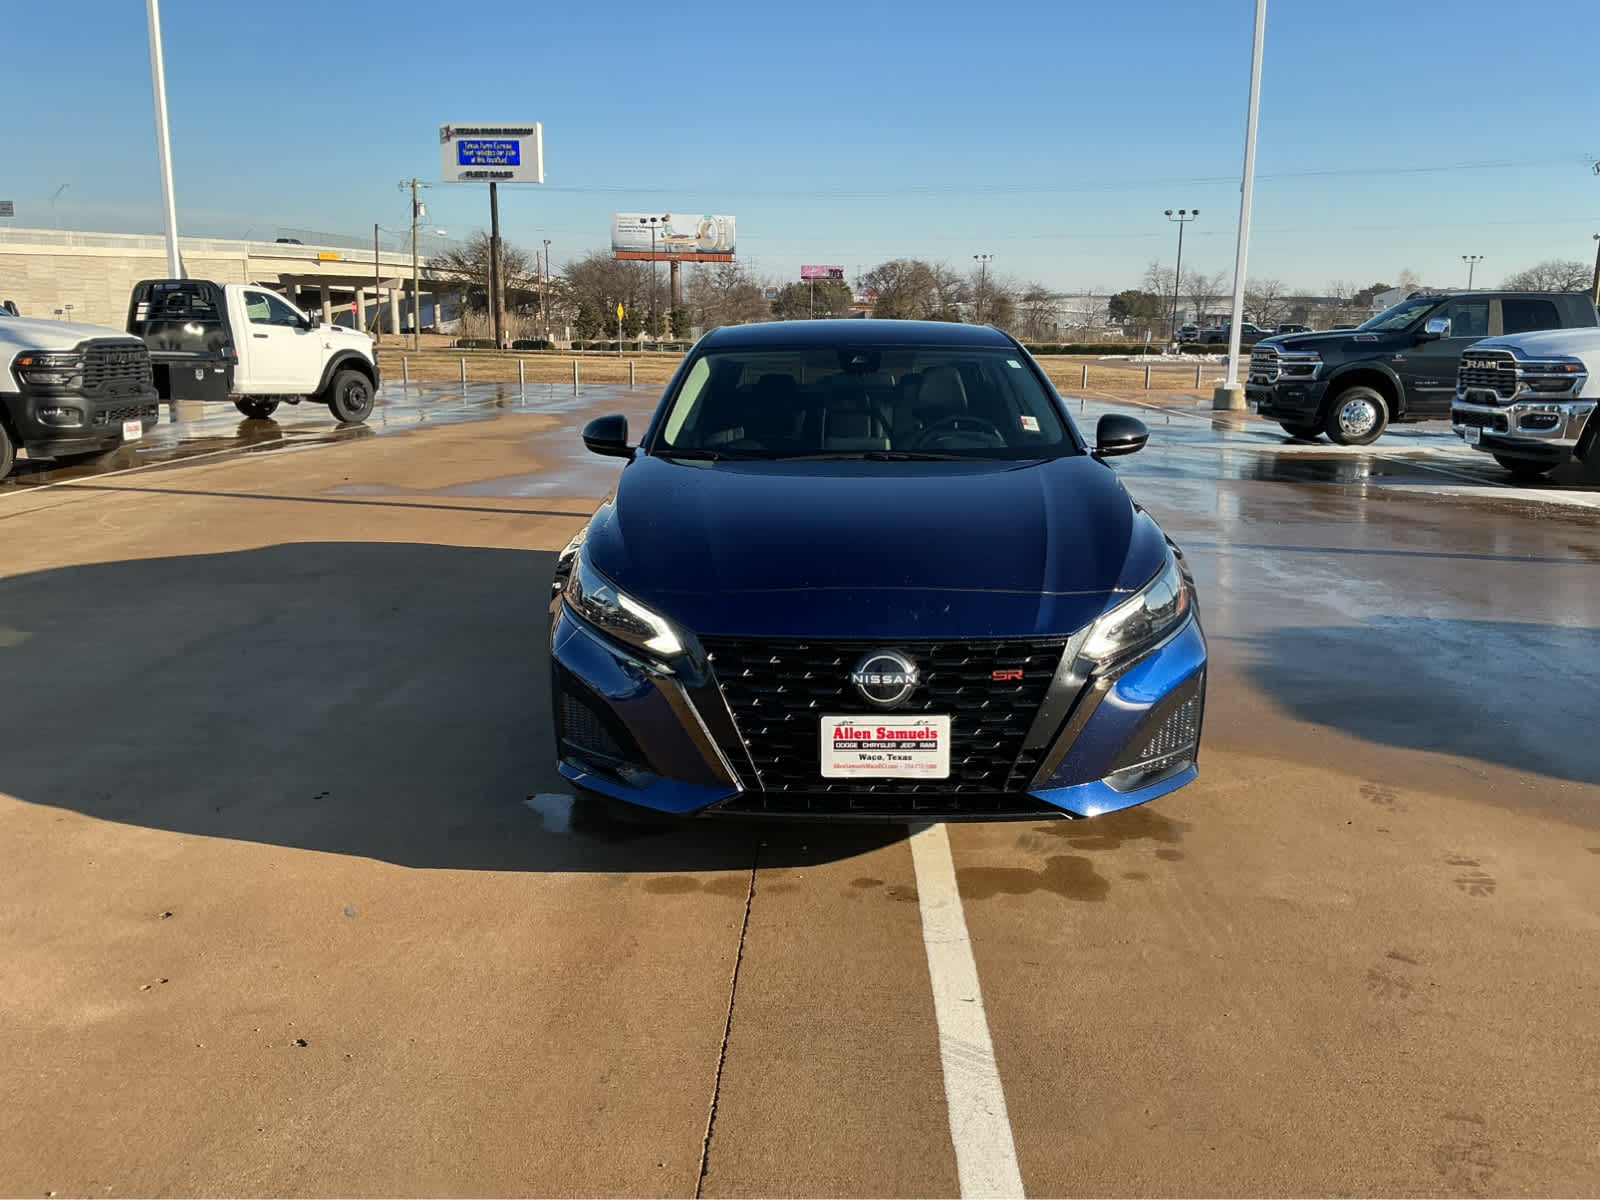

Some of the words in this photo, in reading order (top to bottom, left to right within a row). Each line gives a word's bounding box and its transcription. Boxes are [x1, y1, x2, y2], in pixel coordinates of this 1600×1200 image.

[1467, 360, 1497, 369] RAM
[852, 674, 916, 684] NISSAN
[992, 669, 1023, 681] SR
[833, 727, 871, 740] Allen
[876, 727, 938, 740] Samuels
[858, 753, 885, 762] Waco,
[887, 753, 913, 761] Texas
